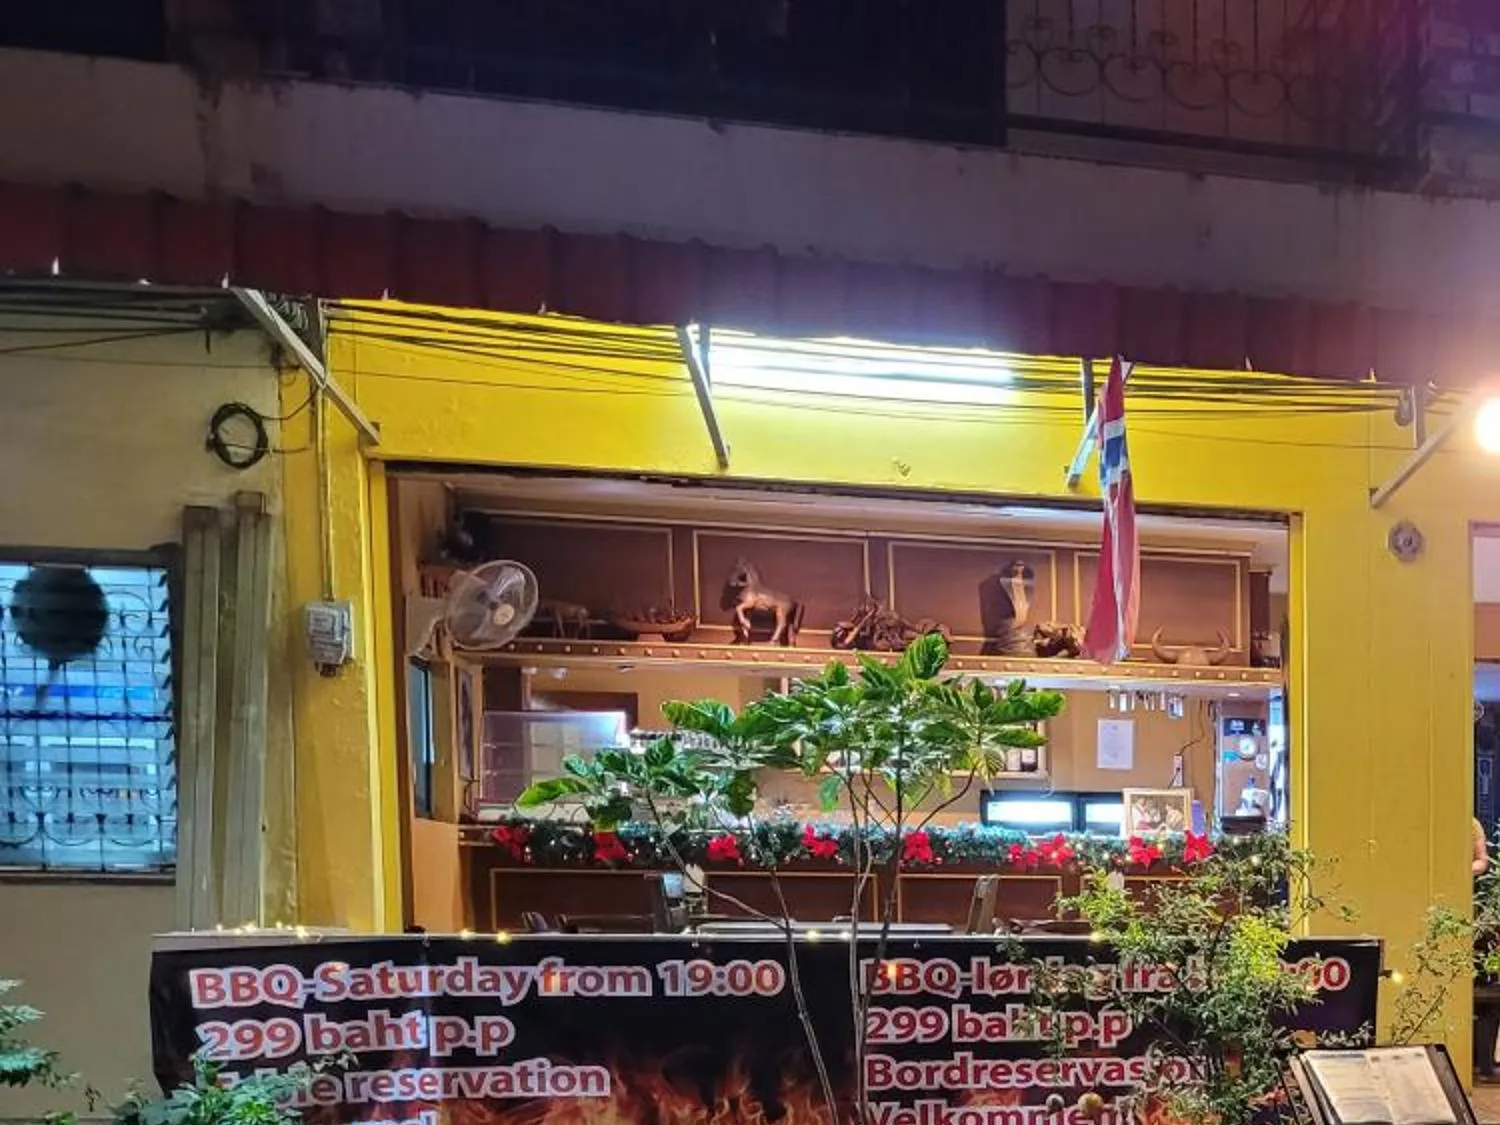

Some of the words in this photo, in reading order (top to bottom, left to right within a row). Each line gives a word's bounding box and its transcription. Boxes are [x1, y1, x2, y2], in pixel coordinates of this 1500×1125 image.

[191, 957, 531, 1006] BBQ-Saturday
[536, 958, 652, 997] from
[656, 960, 785, 997] 19:00
[196, 1020, 301, 1060] 299
[304, 1010, 428, 1053] baht
[430, 1015, 514, 1057] p.p
[866, 1006, 949, 1043] 299
[1061, 1010, 1133, 1048] p.p
[345, 1057, 611, 1102] reservation
